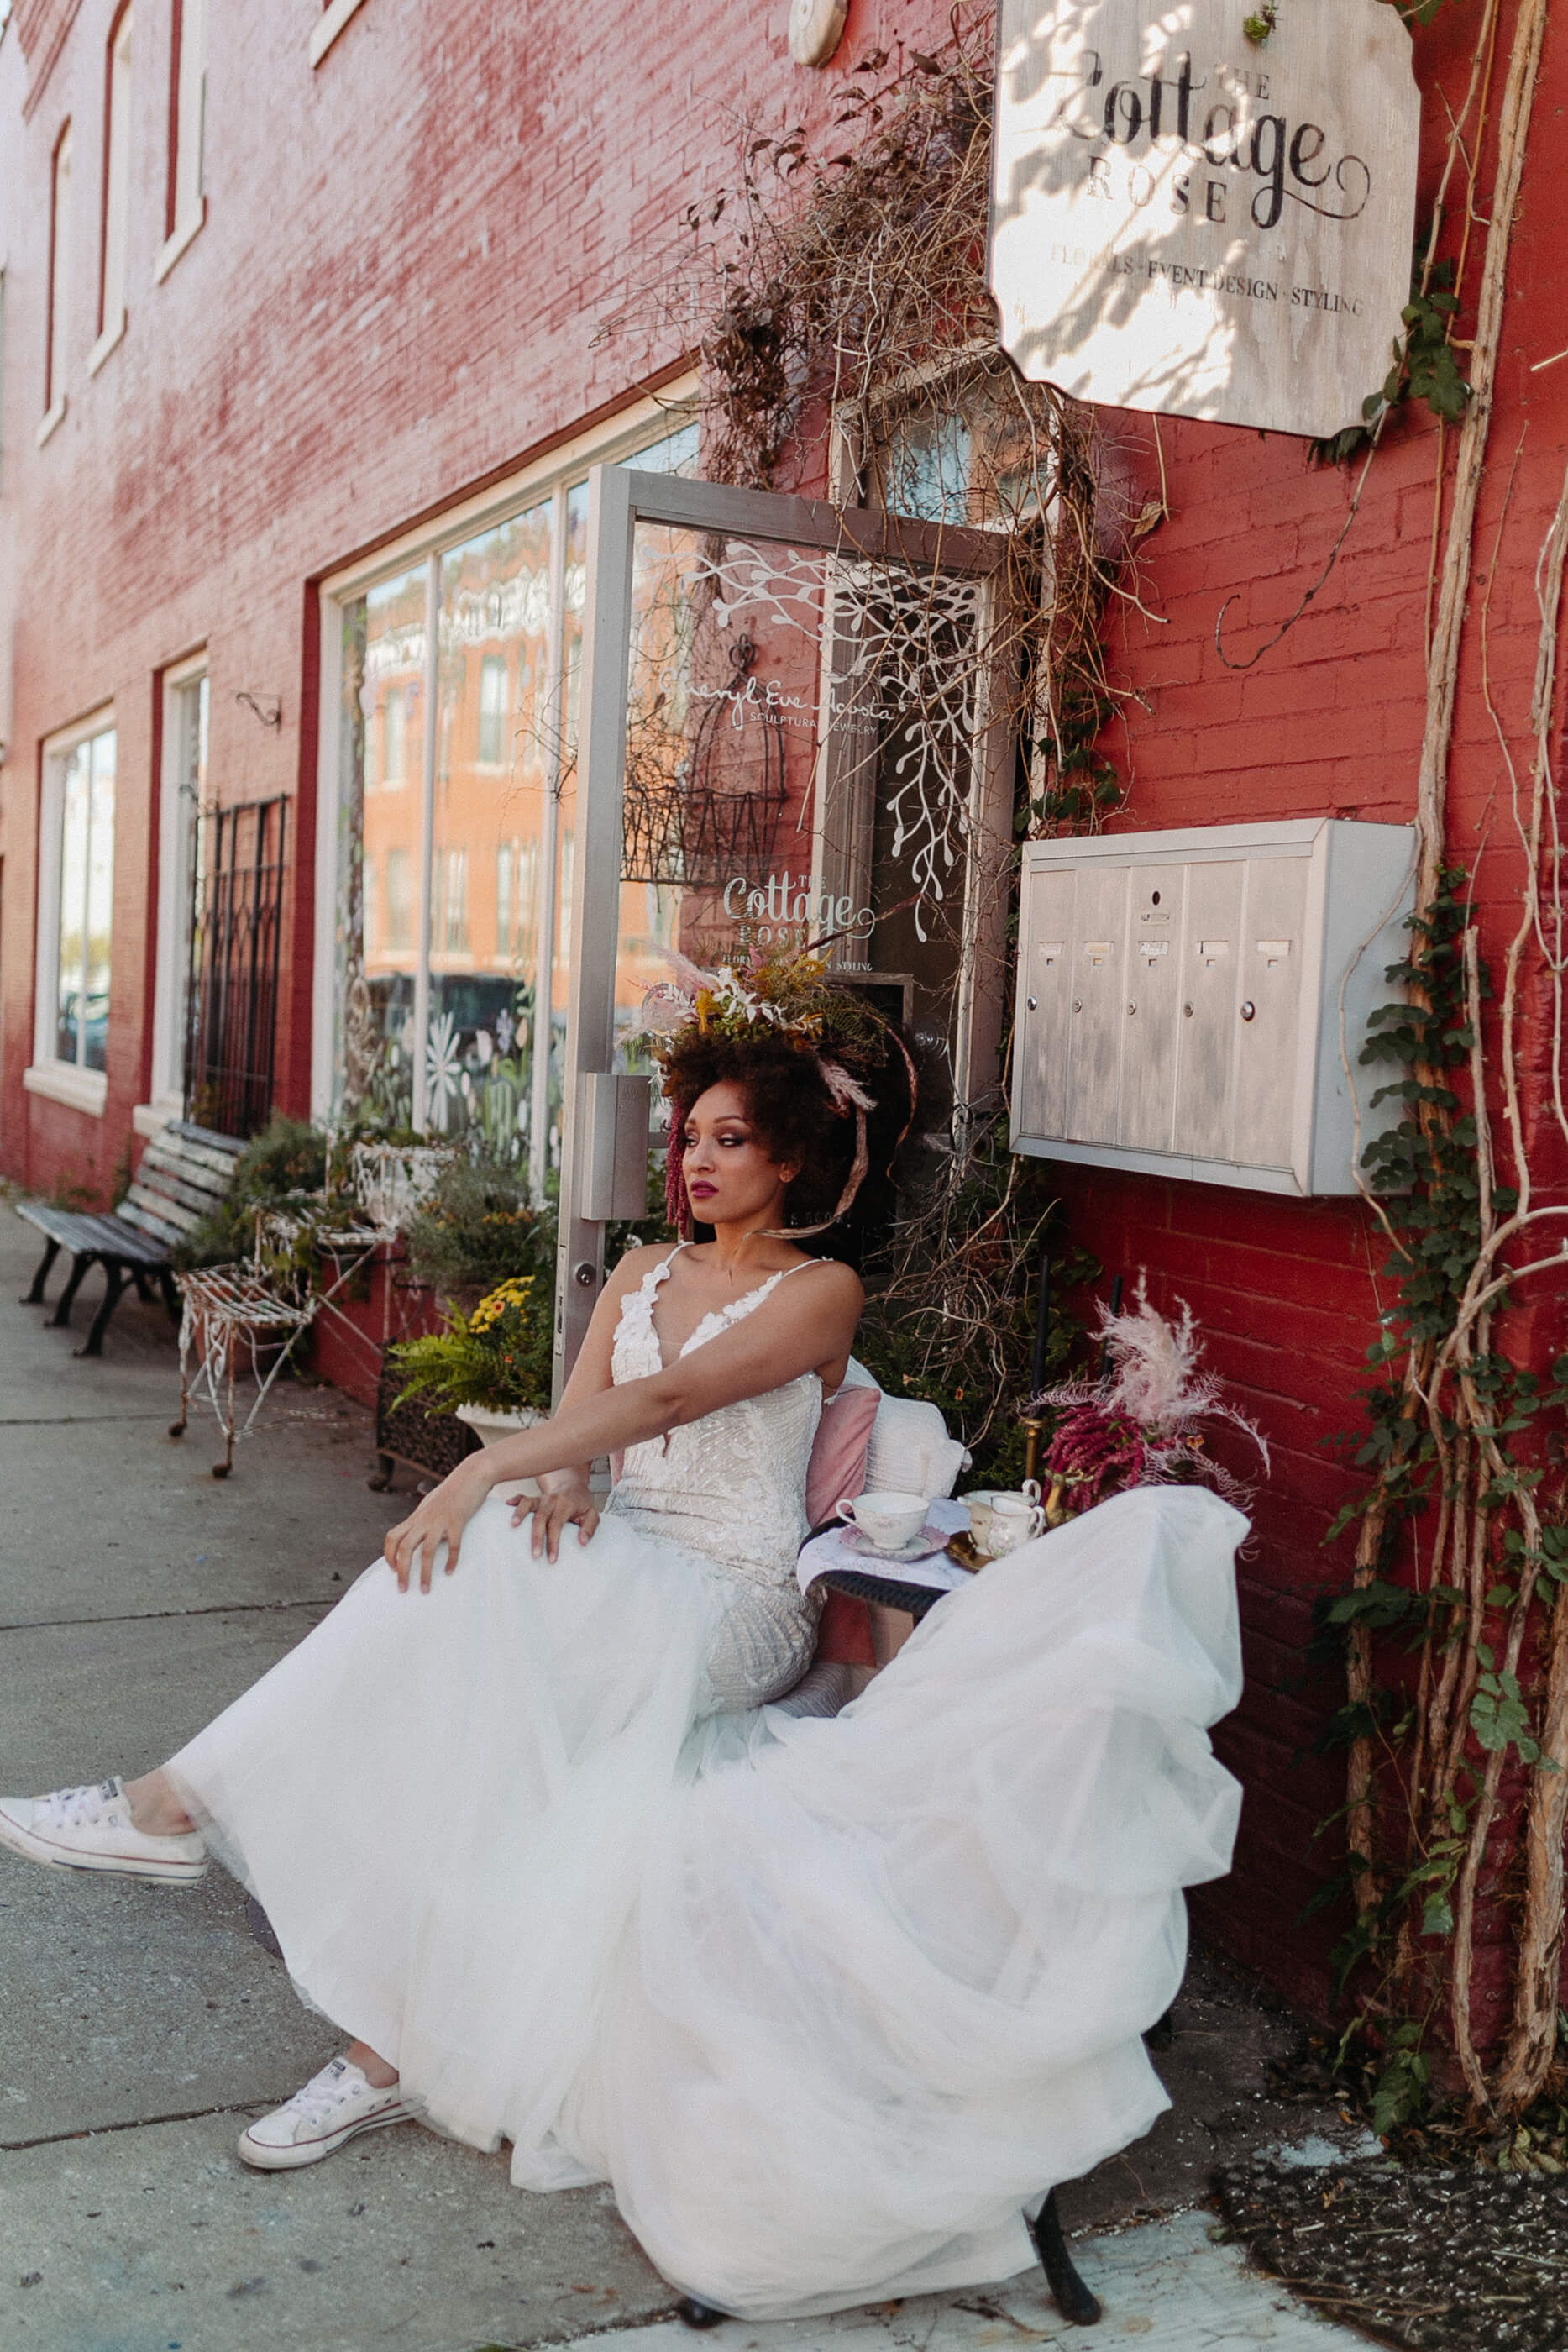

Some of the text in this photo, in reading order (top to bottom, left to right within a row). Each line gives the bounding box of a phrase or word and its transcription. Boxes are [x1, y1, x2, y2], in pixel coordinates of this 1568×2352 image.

[1057, 49, 1371, 230] Cottage
[1087, 155, 1228, 223] ROSE
[1213, 270, 1278, 302] DESIGN
[1291, 286, 1365, 317] STYLING
[658, 667, 762, 731] Cheryl
[765, 680, 808, 709] Eve
[750, 711, 878, 736] SCULPTURA EWELRY
[722, 869, 876, 949] Cottage
[739, 924, 807, 949] ROSE
